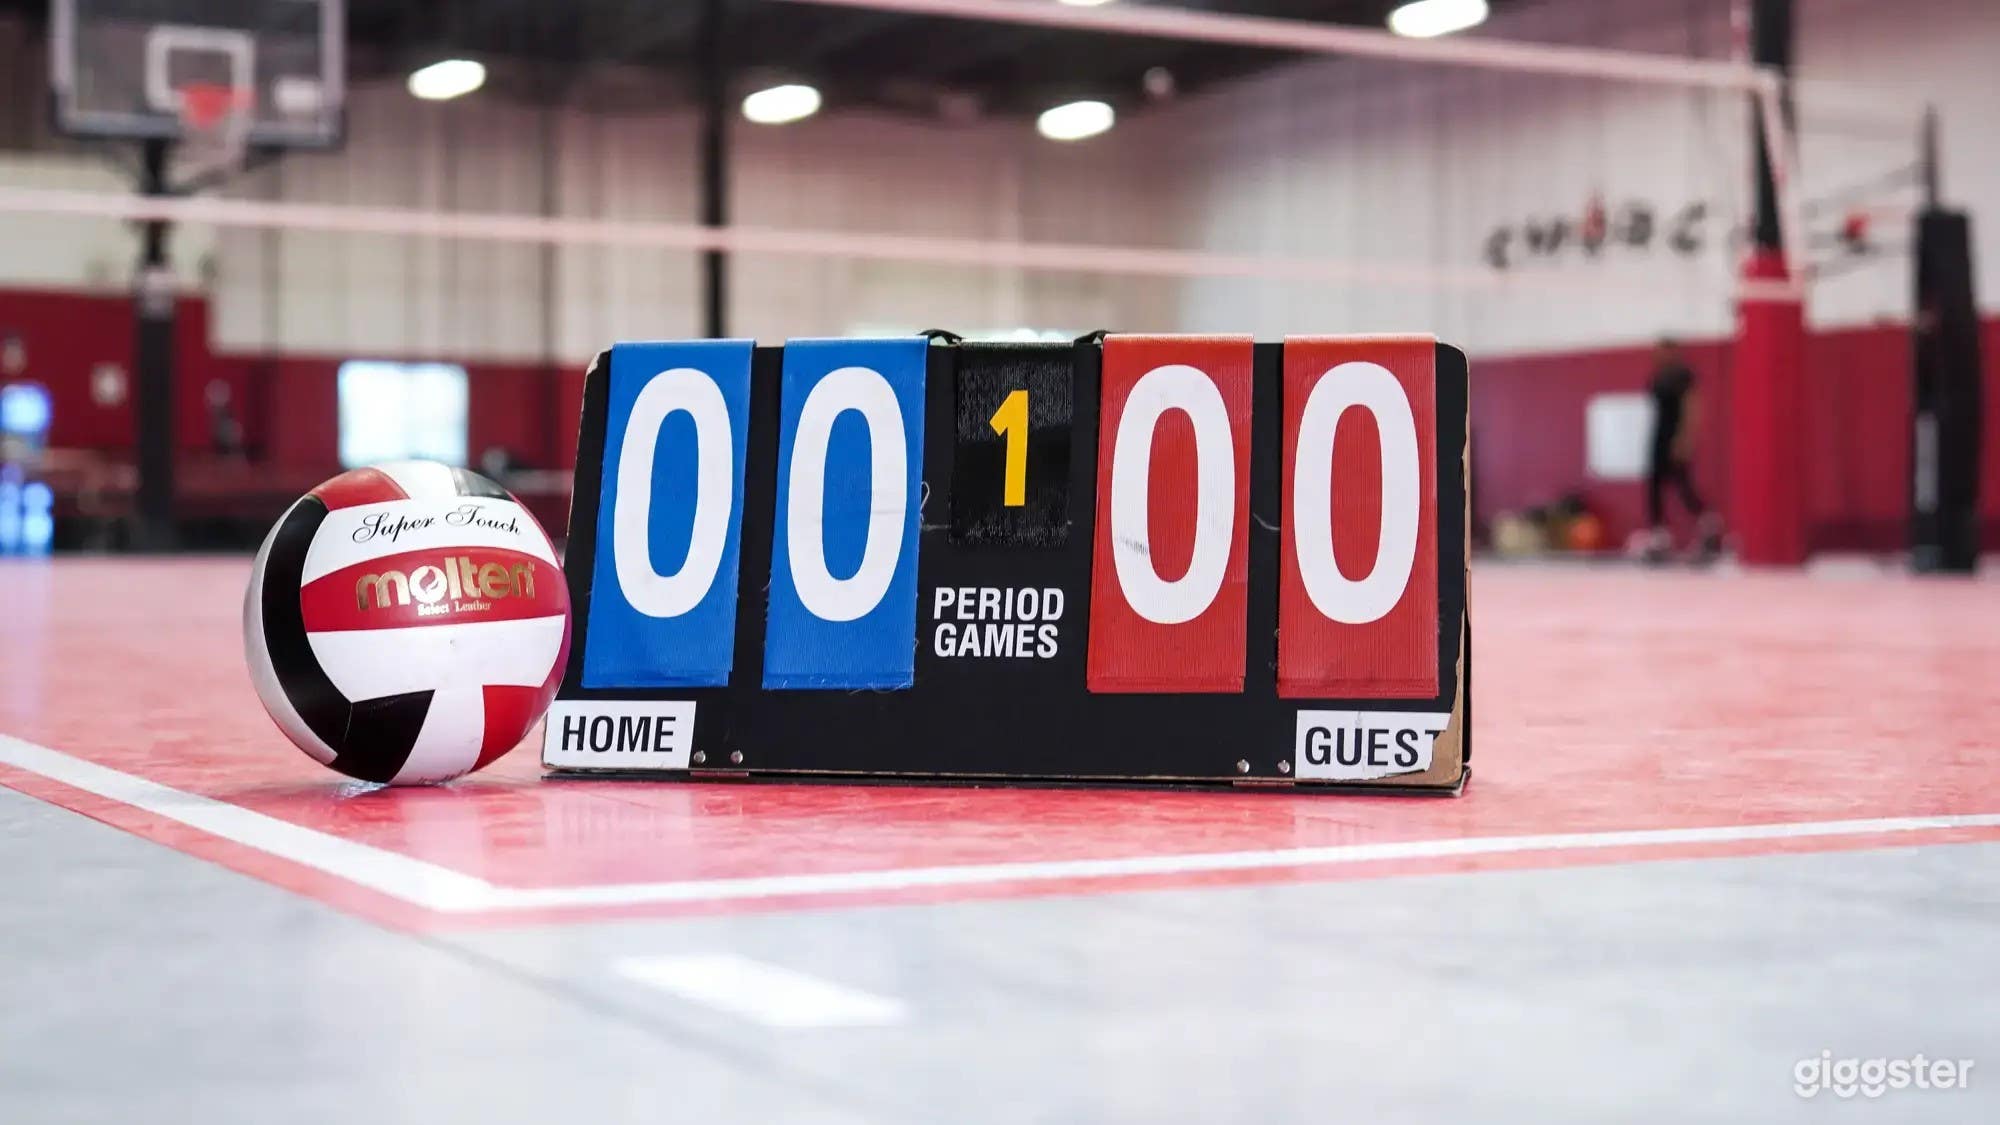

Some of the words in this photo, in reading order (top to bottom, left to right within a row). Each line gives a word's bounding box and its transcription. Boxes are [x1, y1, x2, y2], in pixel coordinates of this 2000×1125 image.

[988, 389, 1029, 507] 1
[352, 512, 436, 544] Super
[445, 504, 521, 535] Touch
[356, 556, 536, 612] molten
[417, 602, 450, 616] Select
[455, 600, 492, 613] Leather
[933, 586, 1065, 621] PERIOD
[934, 622, 1059, 659] GAMES
[561, 715, 677, 753] HOME
